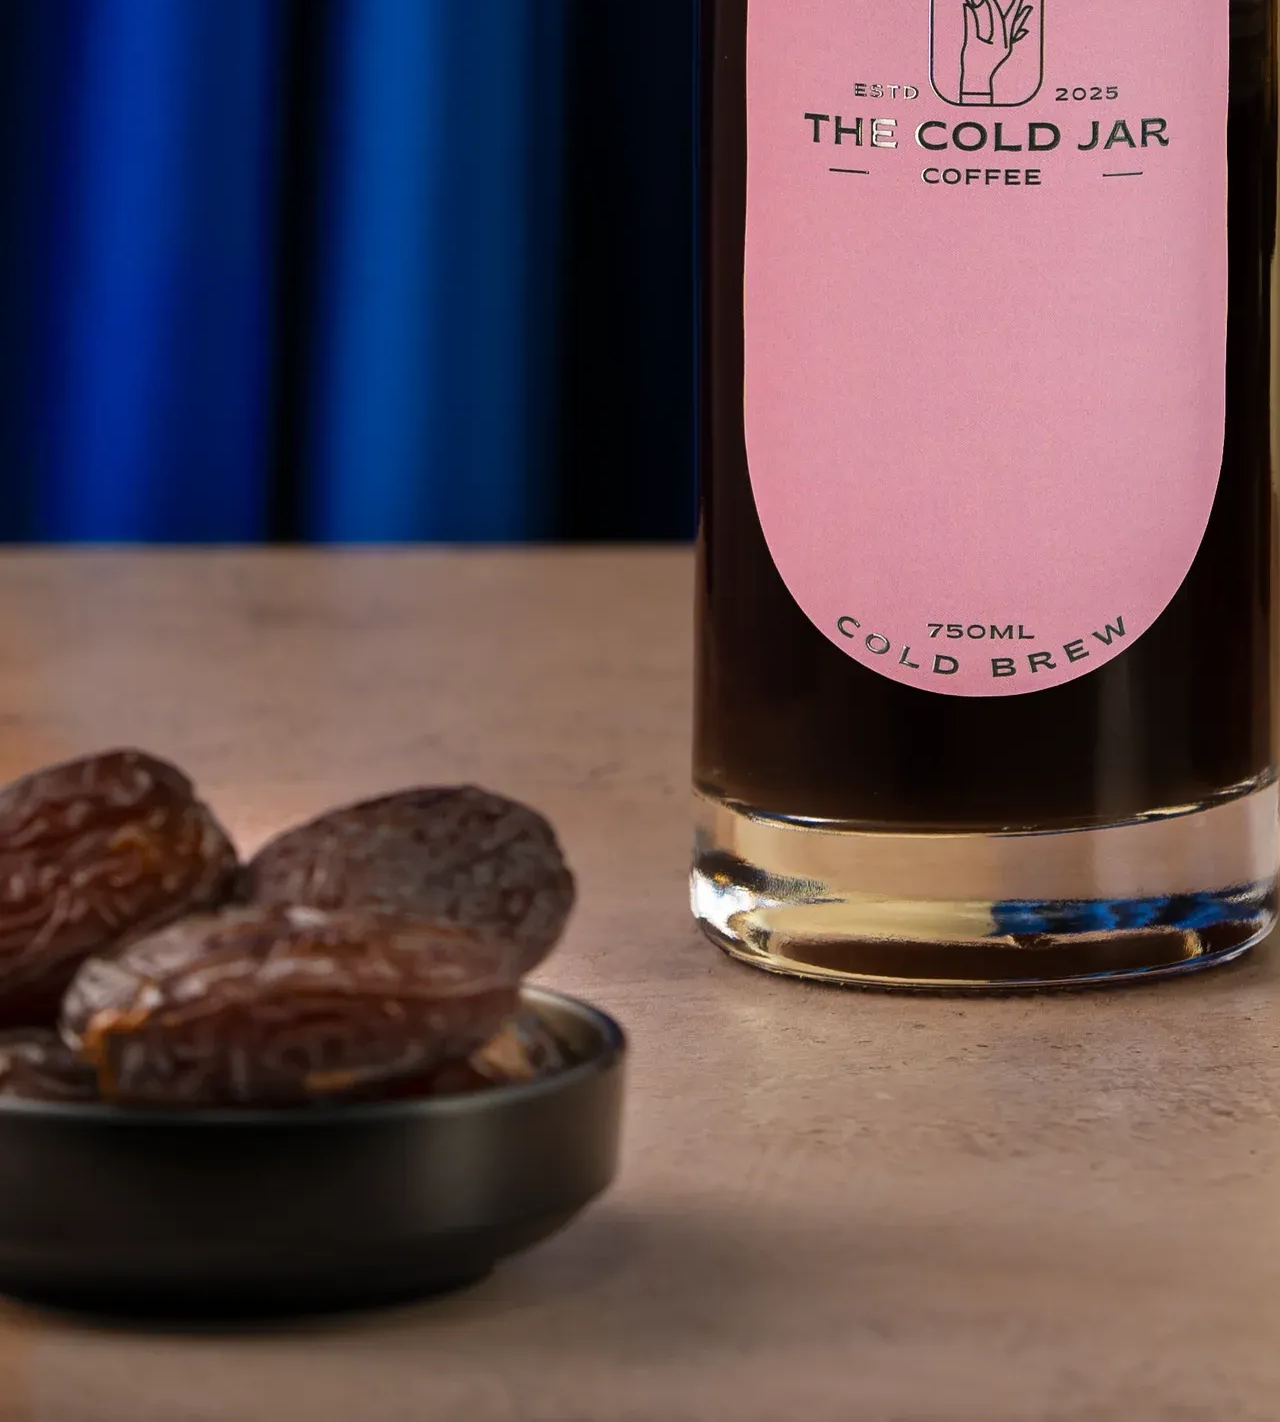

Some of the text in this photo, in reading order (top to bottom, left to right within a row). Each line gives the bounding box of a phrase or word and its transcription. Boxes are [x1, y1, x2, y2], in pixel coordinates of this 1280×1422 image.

[855, 84, 1118, 101] ESTD 2025
[805, 113, 1169, 151] THE COLD JAR
[922, 168, 1041, 185] COFFEE
[927, 623, 1034, 639] 750ML
[837, 616, 1127, 677] COLD BREW
